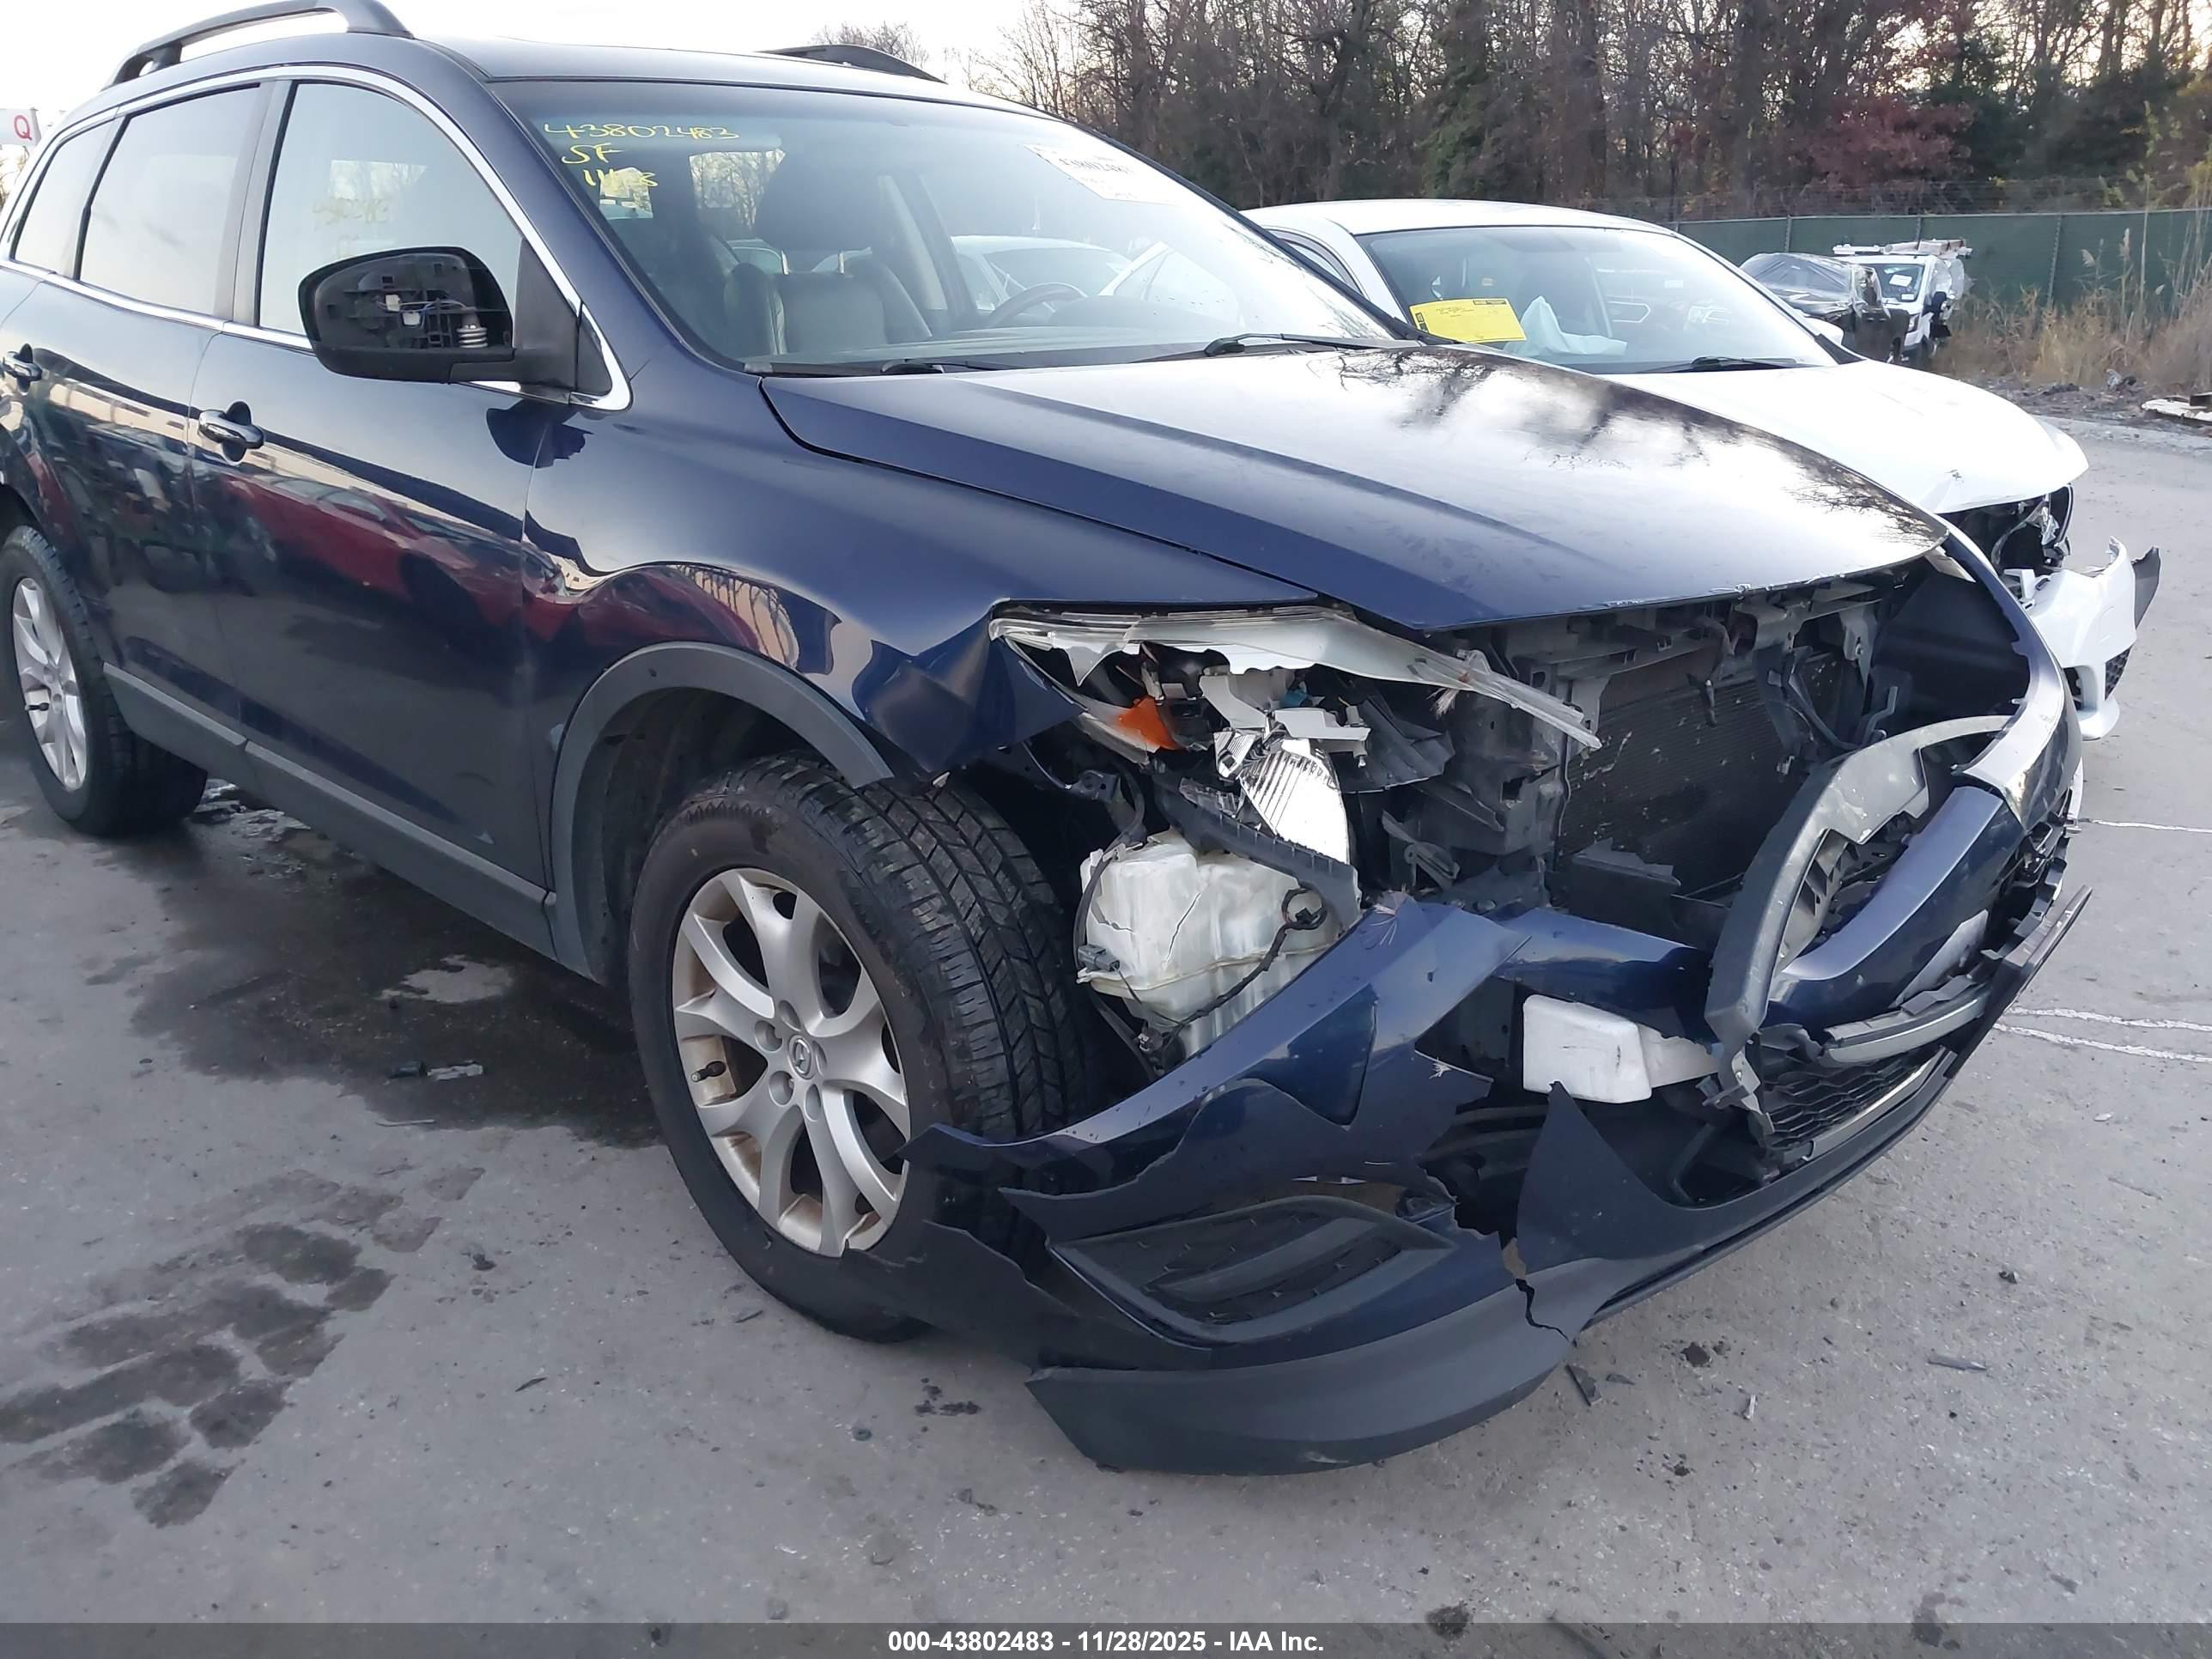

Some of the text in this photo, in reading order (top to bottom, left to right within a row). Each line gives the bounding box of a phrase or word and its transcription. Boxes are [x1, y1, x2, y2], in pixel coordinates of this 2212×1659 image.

[14, 115, 33, 141] Q
[543, 123, 740, 140] 43802483
[561, 143, 625, 164] SF
